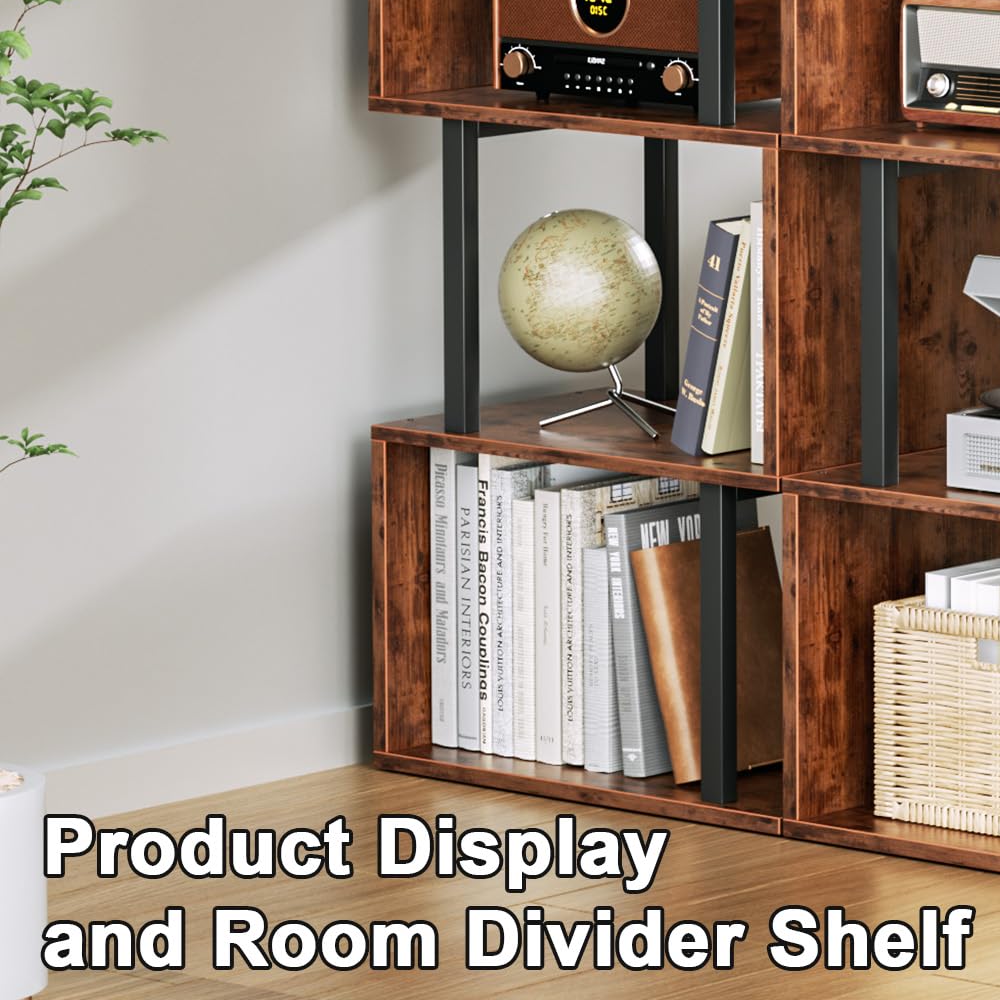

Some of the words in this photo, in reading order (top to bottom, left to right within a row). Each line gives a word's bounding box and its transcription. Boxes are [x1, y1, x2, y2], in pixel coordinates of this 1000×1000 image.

[707, 254, 721, 272] 41
[434, 463, 447, 508] Picasso
[478, 479, 489, 544] Francis
[435, 514, 448, 574] Minotaurs
[460, 507, 471, 590] PARISIAN
[606, 527, 619, 547] NEW
[609, 551, 621, 573] YORK
[435, 581, 449, 604] and
[478, 551, 489, 606] Bacon
[612, 577, 625, 620] INTERIORS
[435, 609, 450, 664] Matadors
[460, 597, 472, 690] INTERIORS
[479, 612, 490, 701] Couplings
